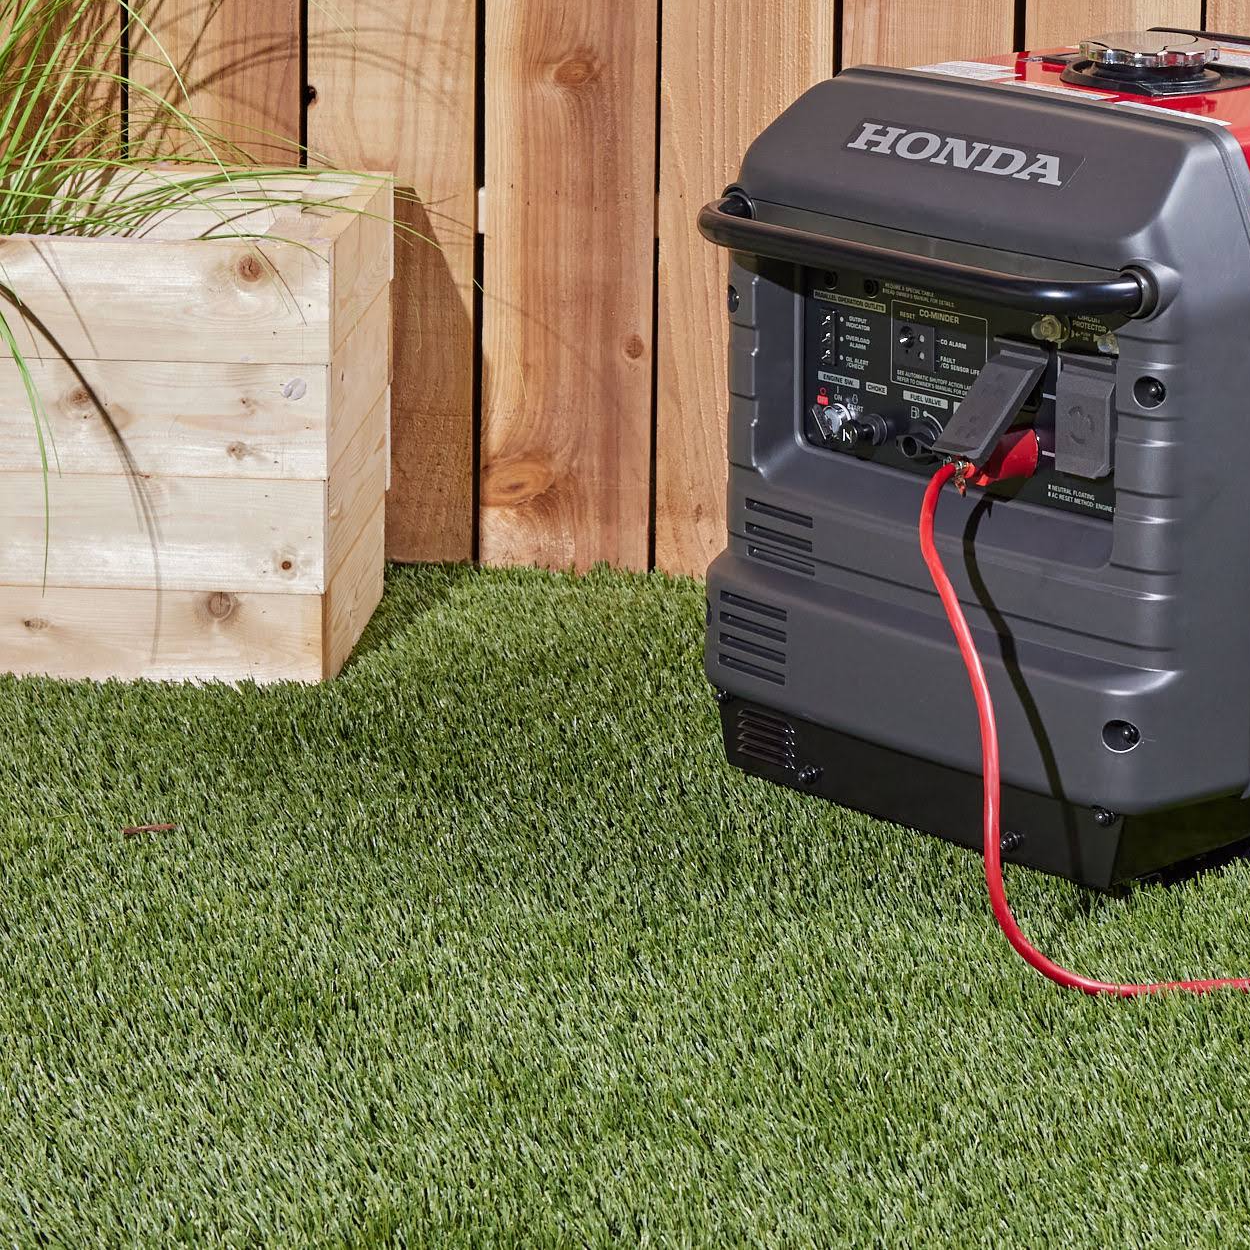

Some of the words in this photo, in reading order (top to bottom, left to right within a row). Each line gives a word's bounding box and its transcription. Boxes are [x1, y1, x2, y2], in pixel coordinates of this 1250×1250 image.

[847, 122, 1062, 186] HONDA
[815, 291, 837, 301] PARALLEL
[838, 296, 863, 307] OPERATION
[864, 302, 884, 311] OUTLETS
[849, 316, 867, 324] OUTPUT
[900, 311, 915, 319] RESET
[919, 309, 960, 324] CO-MINDER
[846, 322, 870, 331] INDICATOR
[1072, 320, 1106, 333] PROTECTOR
[846, 335, 870, 345] OVERLOAD
[949, 340, 967, 350] ALARM
[850, 342, 866, 350] ALARM
[940, 356, 956, 364] FAULT
[951, 364, 969, 373] SENSOR
[823, 374, 843, 384] ENGINE
[905, 371, 928, 381] AUTOMATIC
[930, 376, 948, 385] SHUTOFF
[867, 383, 886, 393] CHOKE
[916, 380, 934, 389] OWNER'S
[935, 384, 952, 393] MANUAL
[911, 393, 923, 401] FUEL
[924, 397, 942, 405] VALVE
[1052, 485, 1072, 495] NEUTRAL
[1073, 490, 1095, 500] FLOATING
[1059, 494, 1073, 502] RESET
[1095, 503, 1112, 512] ENGINE
